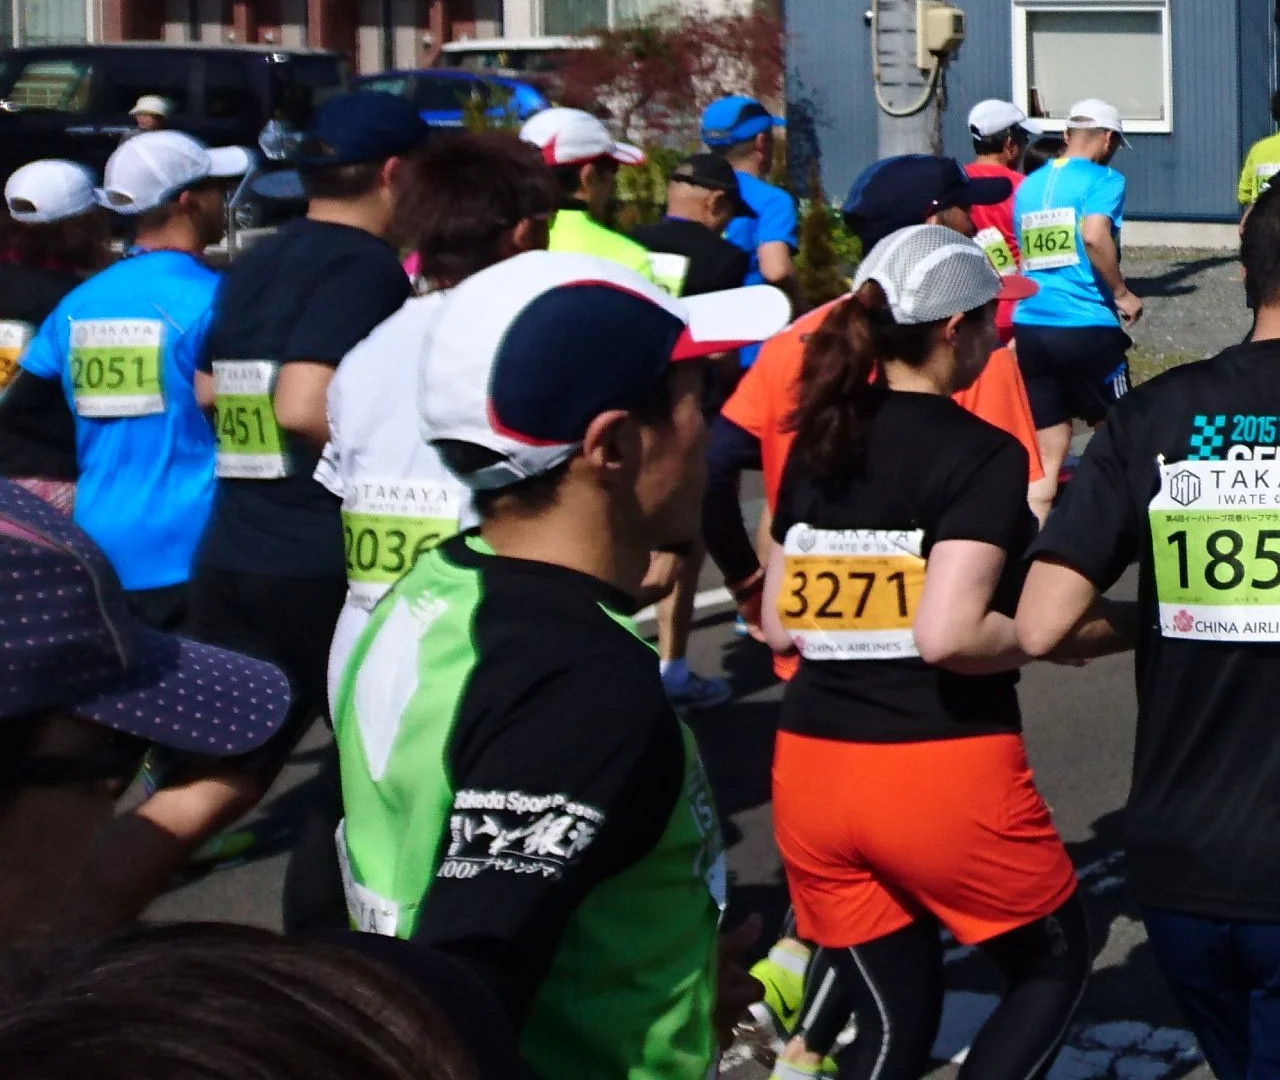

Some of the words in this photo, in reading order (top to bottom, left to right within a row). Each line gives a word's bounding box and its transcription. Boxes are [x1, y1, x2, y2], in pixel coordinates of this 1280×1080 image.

[1025, 230, 1071, 255] 1462
[90, 325, 154, 336] TAKAYA
[72, 357, 144, 388] 2051
[364, 484, 448, 502] TAKAYA
[1218, 494, 1266, 505] IWATE
[784, 571, 908, 618] 3271
[1195, 621, 1239, 634] CHINA
[807, 643, 844, 652] CHINA
[846, 642, 900, 652] AIRLINES
